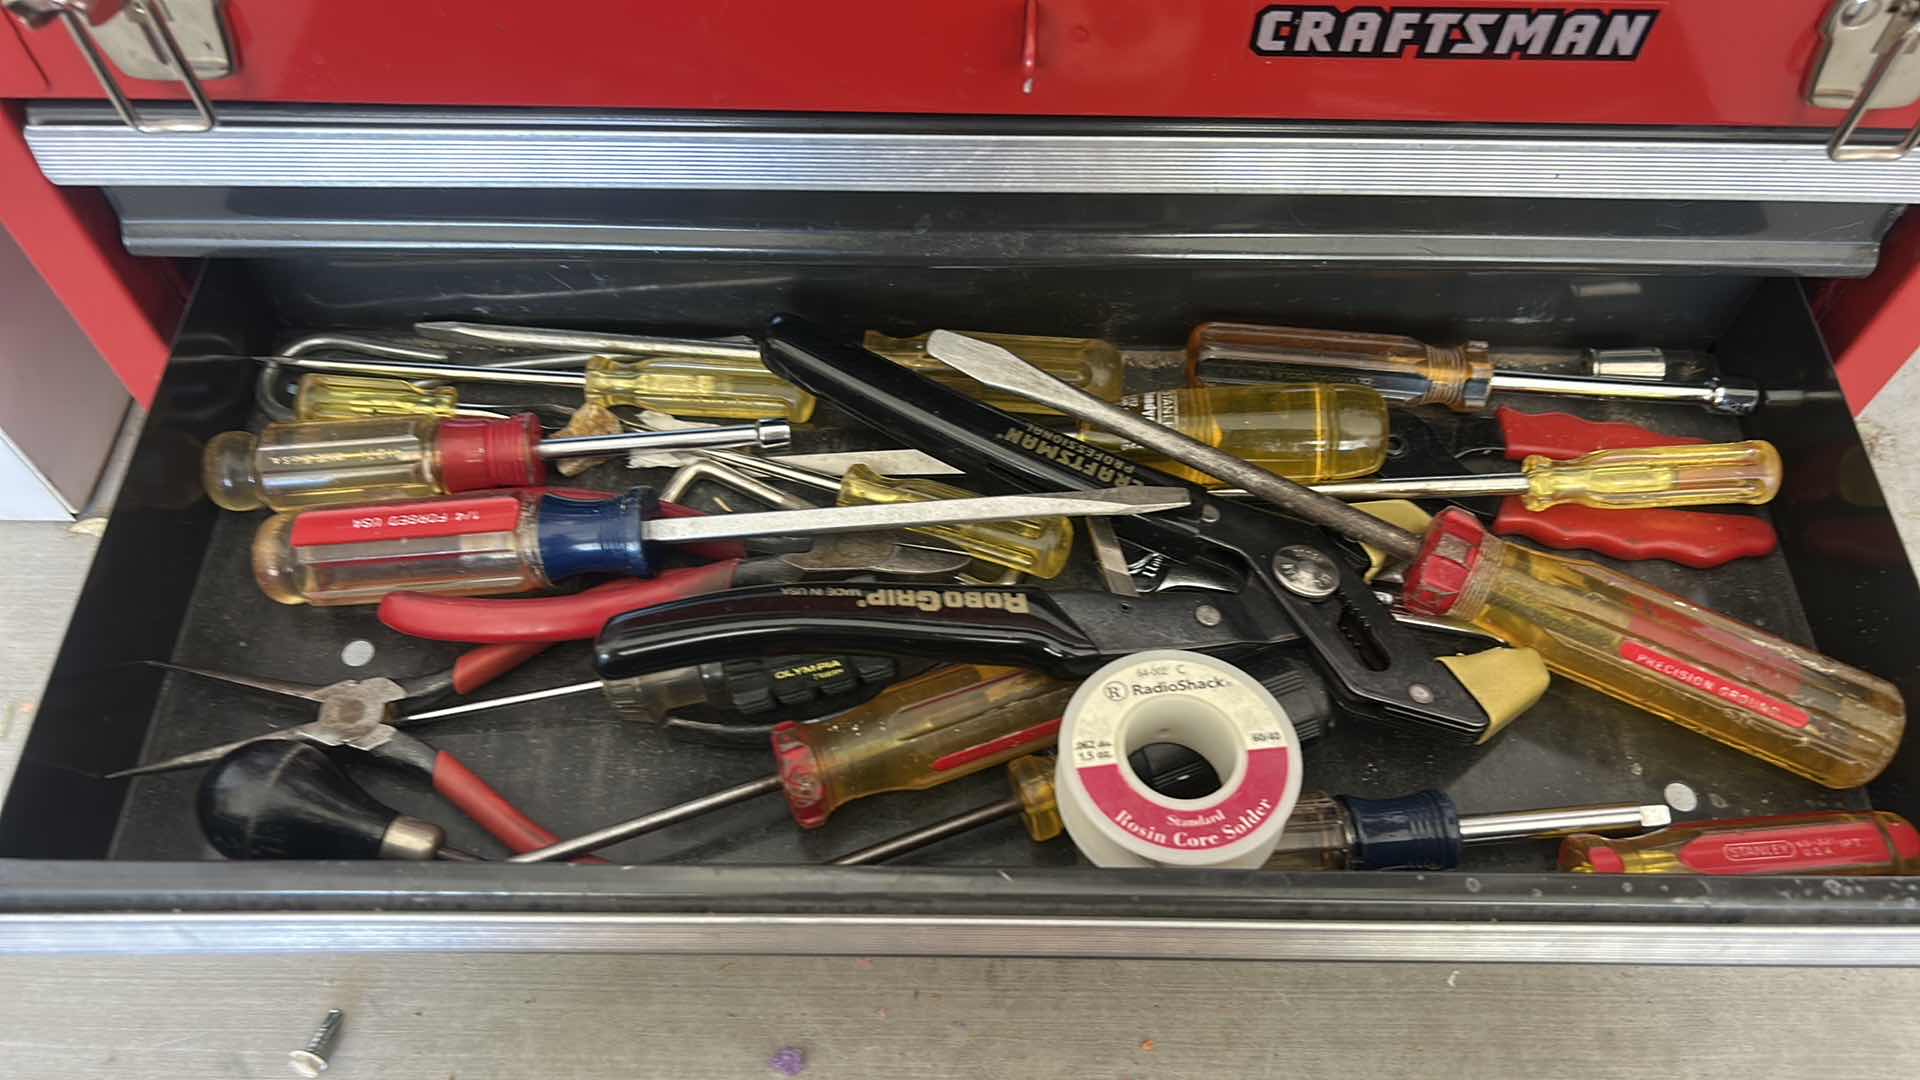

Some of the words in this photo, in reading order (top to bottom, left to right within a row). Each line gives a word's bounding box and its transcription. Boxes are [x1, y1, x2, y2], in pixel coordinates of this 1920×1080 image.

[1257, 10, 1650, 58] CRAFTSMAN
[1131, 676, 1226, 696] RadioShack
[1634, 652, 1715, 693] PRECISION
[1114, 808, 1168, 845] Rosin
[1172, 831, 1219, 848] Core
[1221, 798, 1272, 840] Solder
[1166, 809, 1226, 827] Standard
